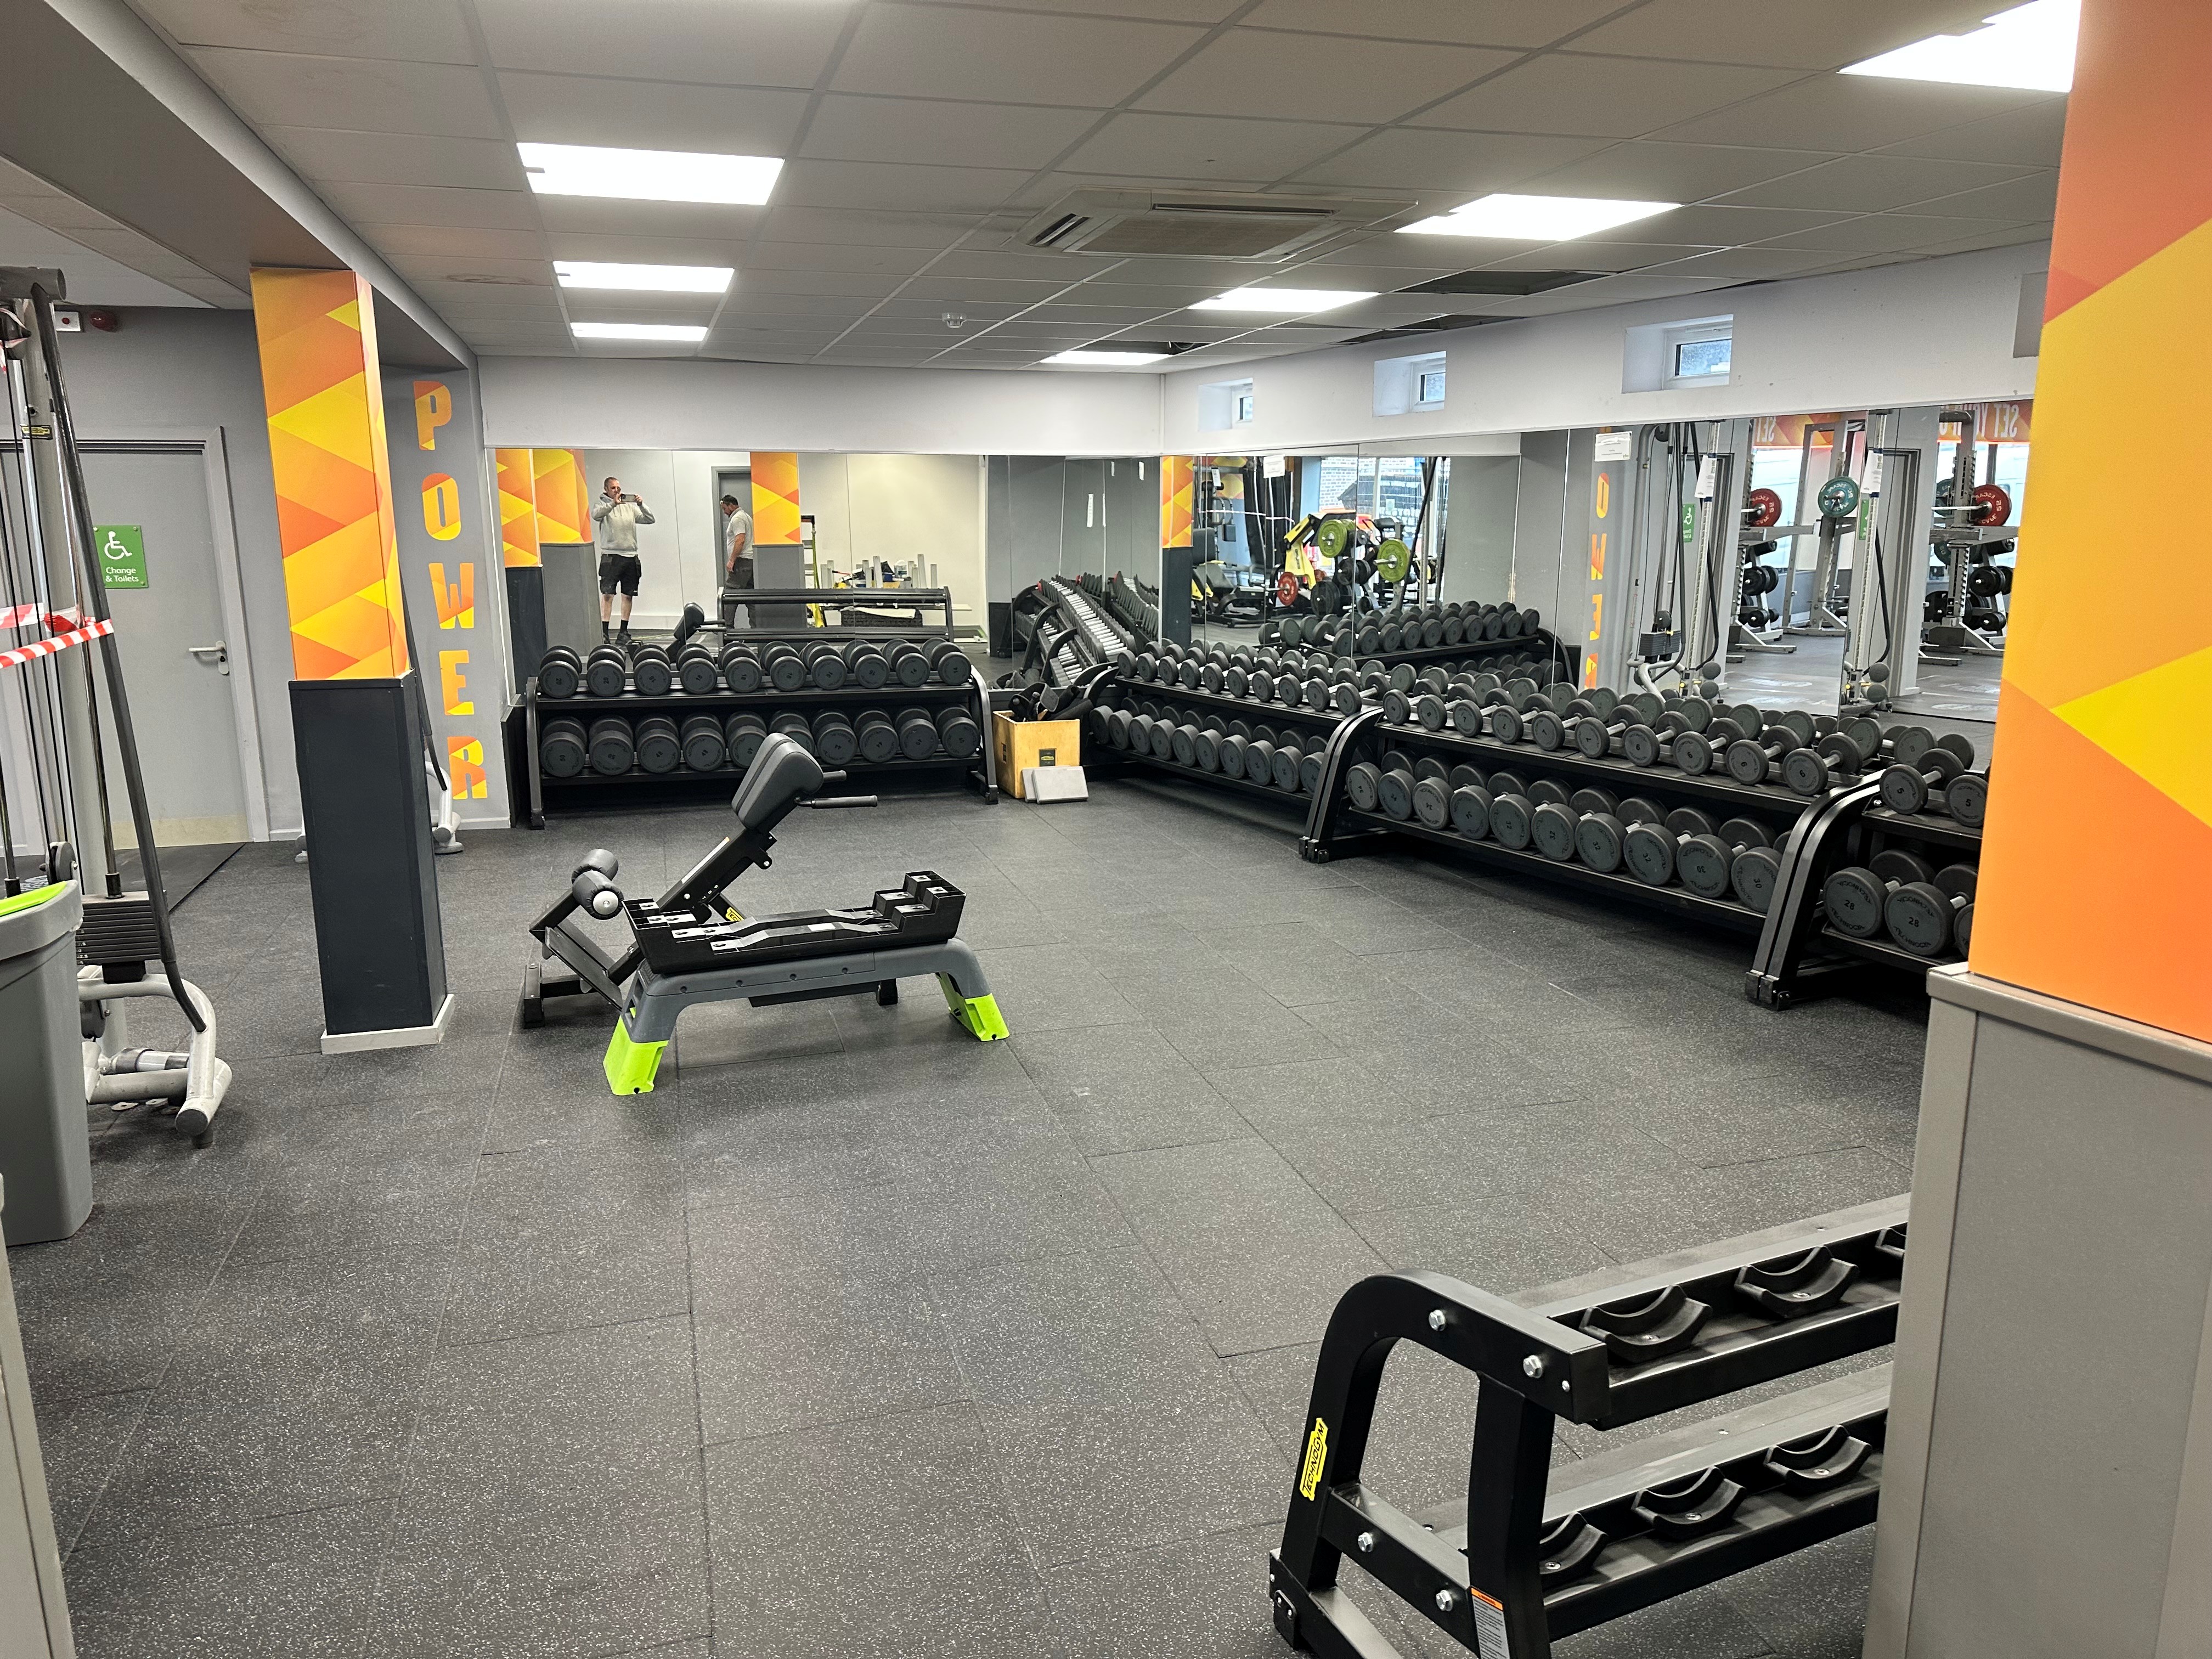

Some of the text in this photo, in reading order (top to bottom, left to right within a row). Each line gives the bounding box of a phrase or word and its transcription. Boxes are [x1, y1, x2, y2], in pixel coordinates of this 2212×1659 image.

[105, 567, 137, 575] Change
[414, 381, 488, 799] POWER
[1505, 820, 1512, 830] 32
[1549, 830, 1556, 840] 32
[1593, 841, 1601, 851] 32
[1643, 853, 1651, 864] 32
[1696, 865, 1706, 873] 30
[1753, 878, 1762, 889] 30
[1844, 899, 1855, 910] 28
[1908, 917, 1920, 928] 28
[1302, 1422, 1324, 1497] TECHNOGYM
